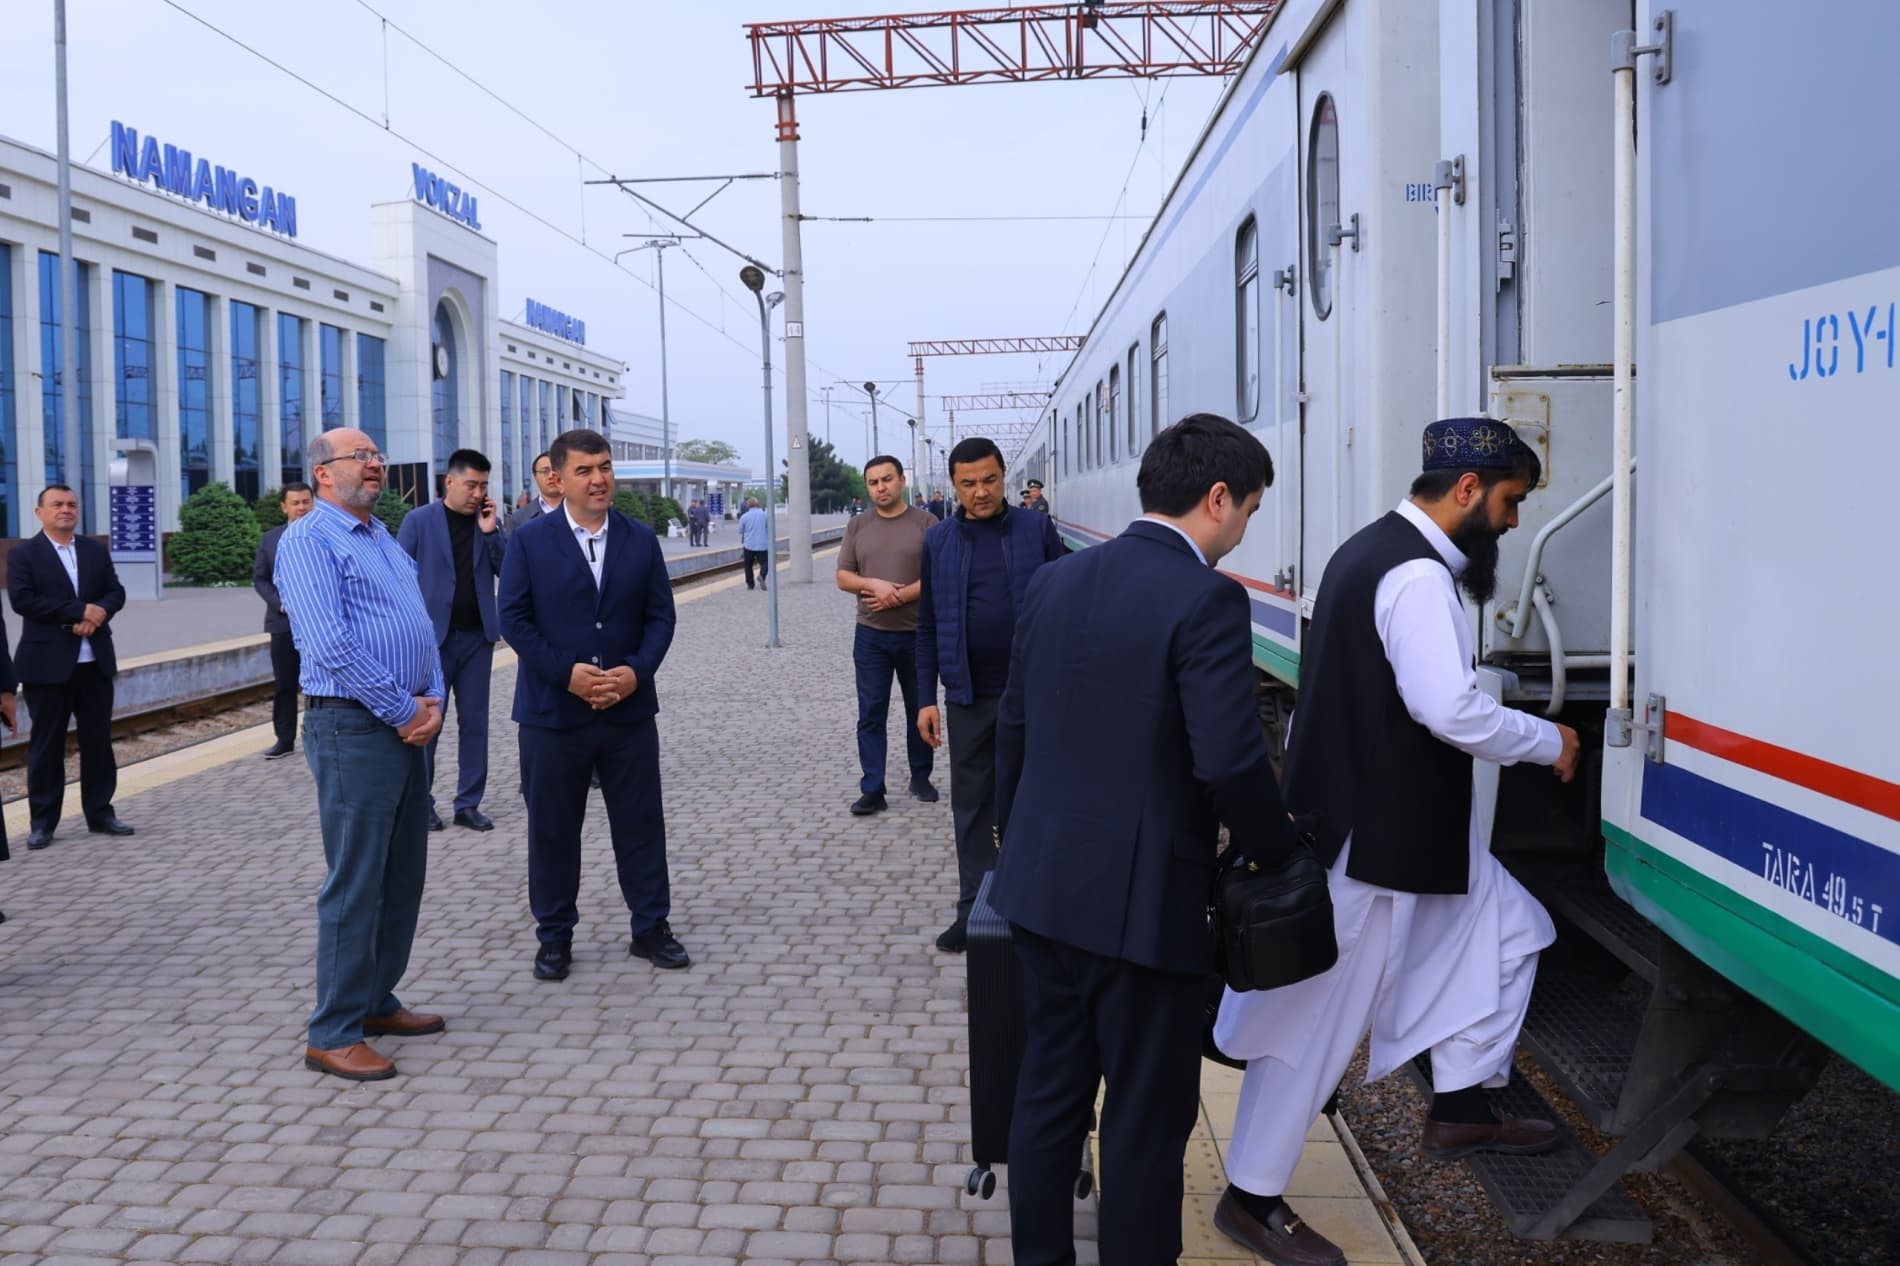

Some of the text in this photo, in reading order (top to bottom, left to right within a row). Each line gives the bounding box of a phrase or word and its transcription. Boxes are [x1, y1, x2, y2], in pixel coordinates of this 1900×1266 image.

[111, 120, 297, 237] NAMANGAN
[412, 162, 481, 231] VOKZAL
[1762, 841, 1816, 904] TARA
[1871, 903, 1883, 933] T
